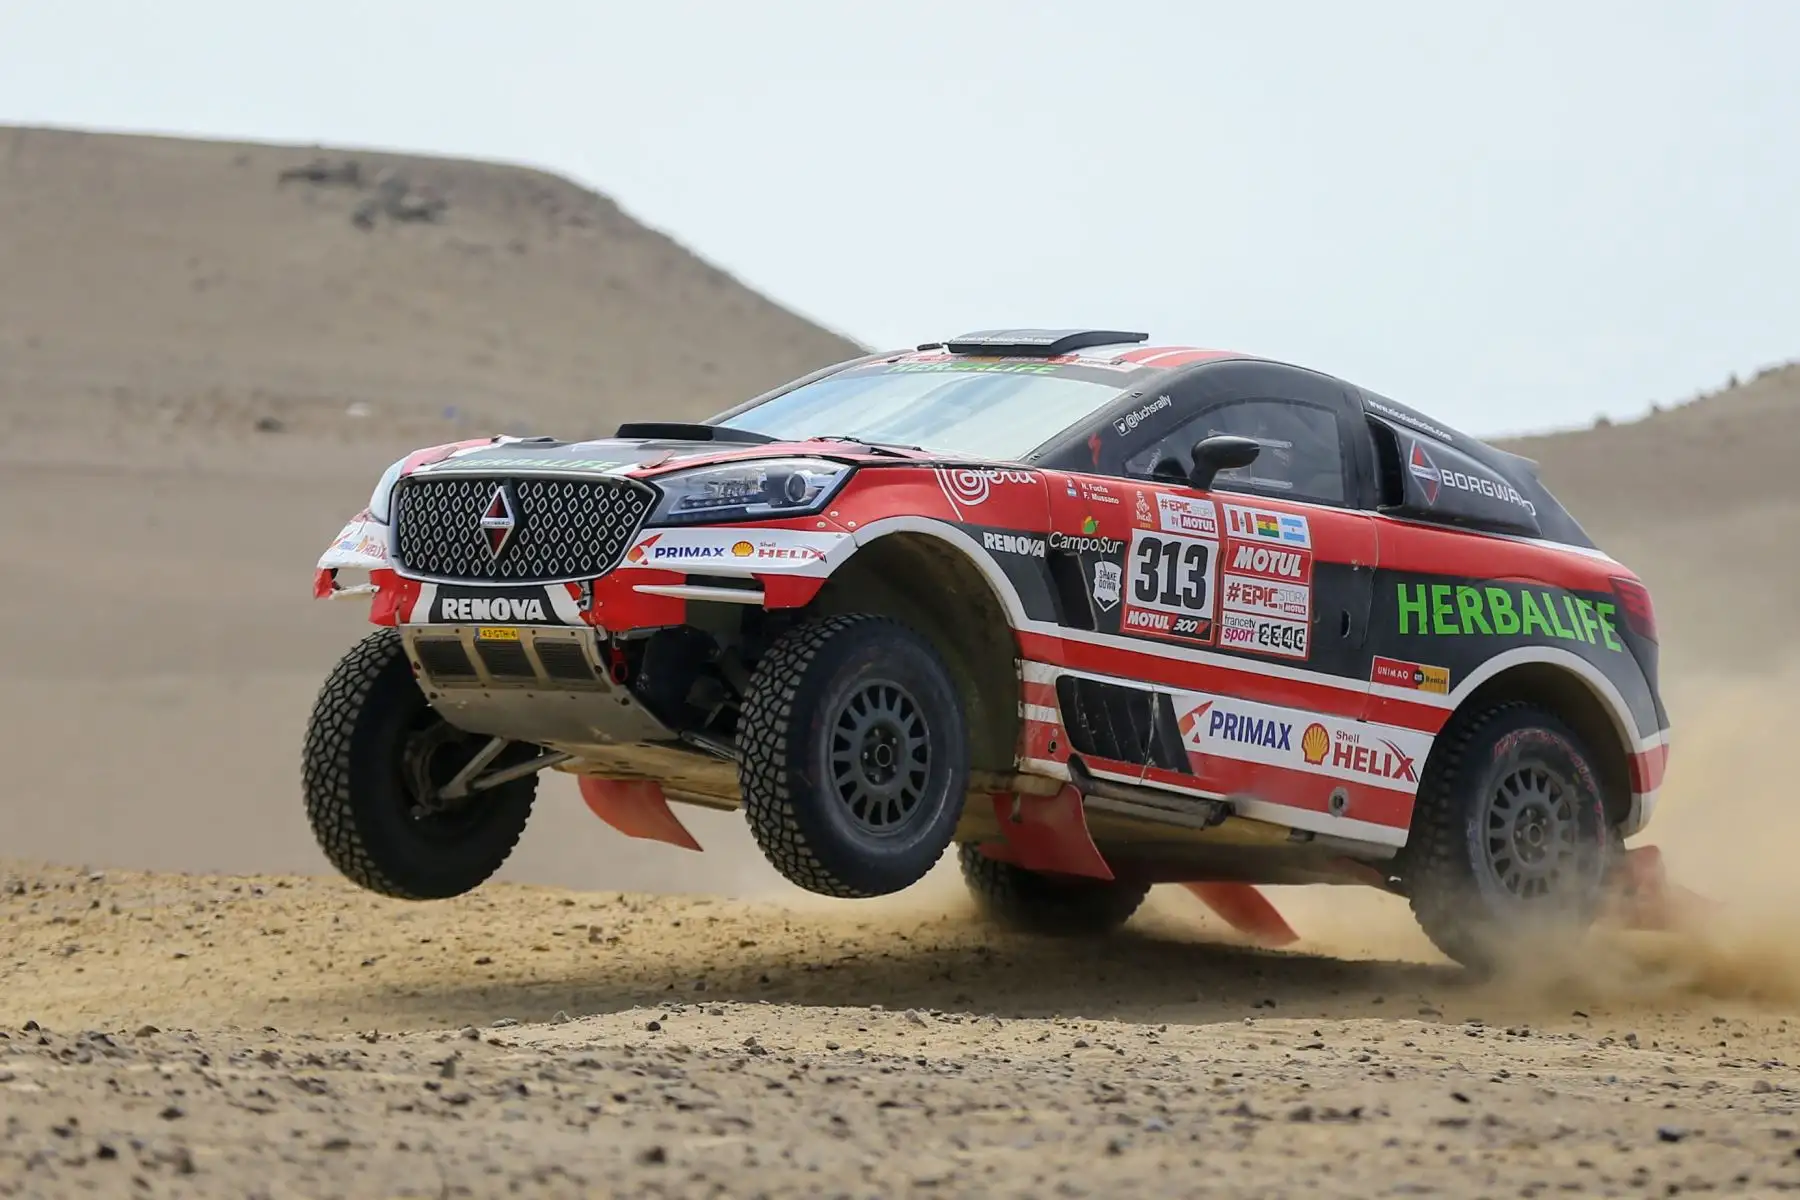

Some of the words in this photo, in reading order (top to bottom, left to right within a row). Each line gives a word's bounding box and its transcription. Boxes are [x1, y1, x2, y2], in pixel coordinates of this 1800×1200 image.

[1125, 395, 1171, 428] @fuchsrally
[1441, 469, 1536, 516] BORGWAD
[1182, 517, 1214, 531] MOTUL
[654, 546, 726, 559] PRIMAX
[983, 531, 1046, 558] RENOVA
[1049, 531, 1120, 554] CampoSur
[758, 546, 828, 563] HELIX
[1232, 545, 1302, 577] MOTUL
[1099, 569, 1118, 582] SHAKE
[1134, 536, 1209, 610] 313
[1098, 579, 1117, 592] DOWN
[442, 598, 548, 621] RENOVA
[1127, 610, 1170, 629] MOTUL
[1284, 604, 1306, 615] MOTUL
[1397, 583, 1623, 652] HERBALIFE
[1224, 614, 1257, 629] francetv
[1224, 626, 1256, 643] sport
[1209, 710, 1293, 751] PRIMAX
[1336, 730, 1360, 743] Shell
[1332, 738, 1419, 783] HELIX
